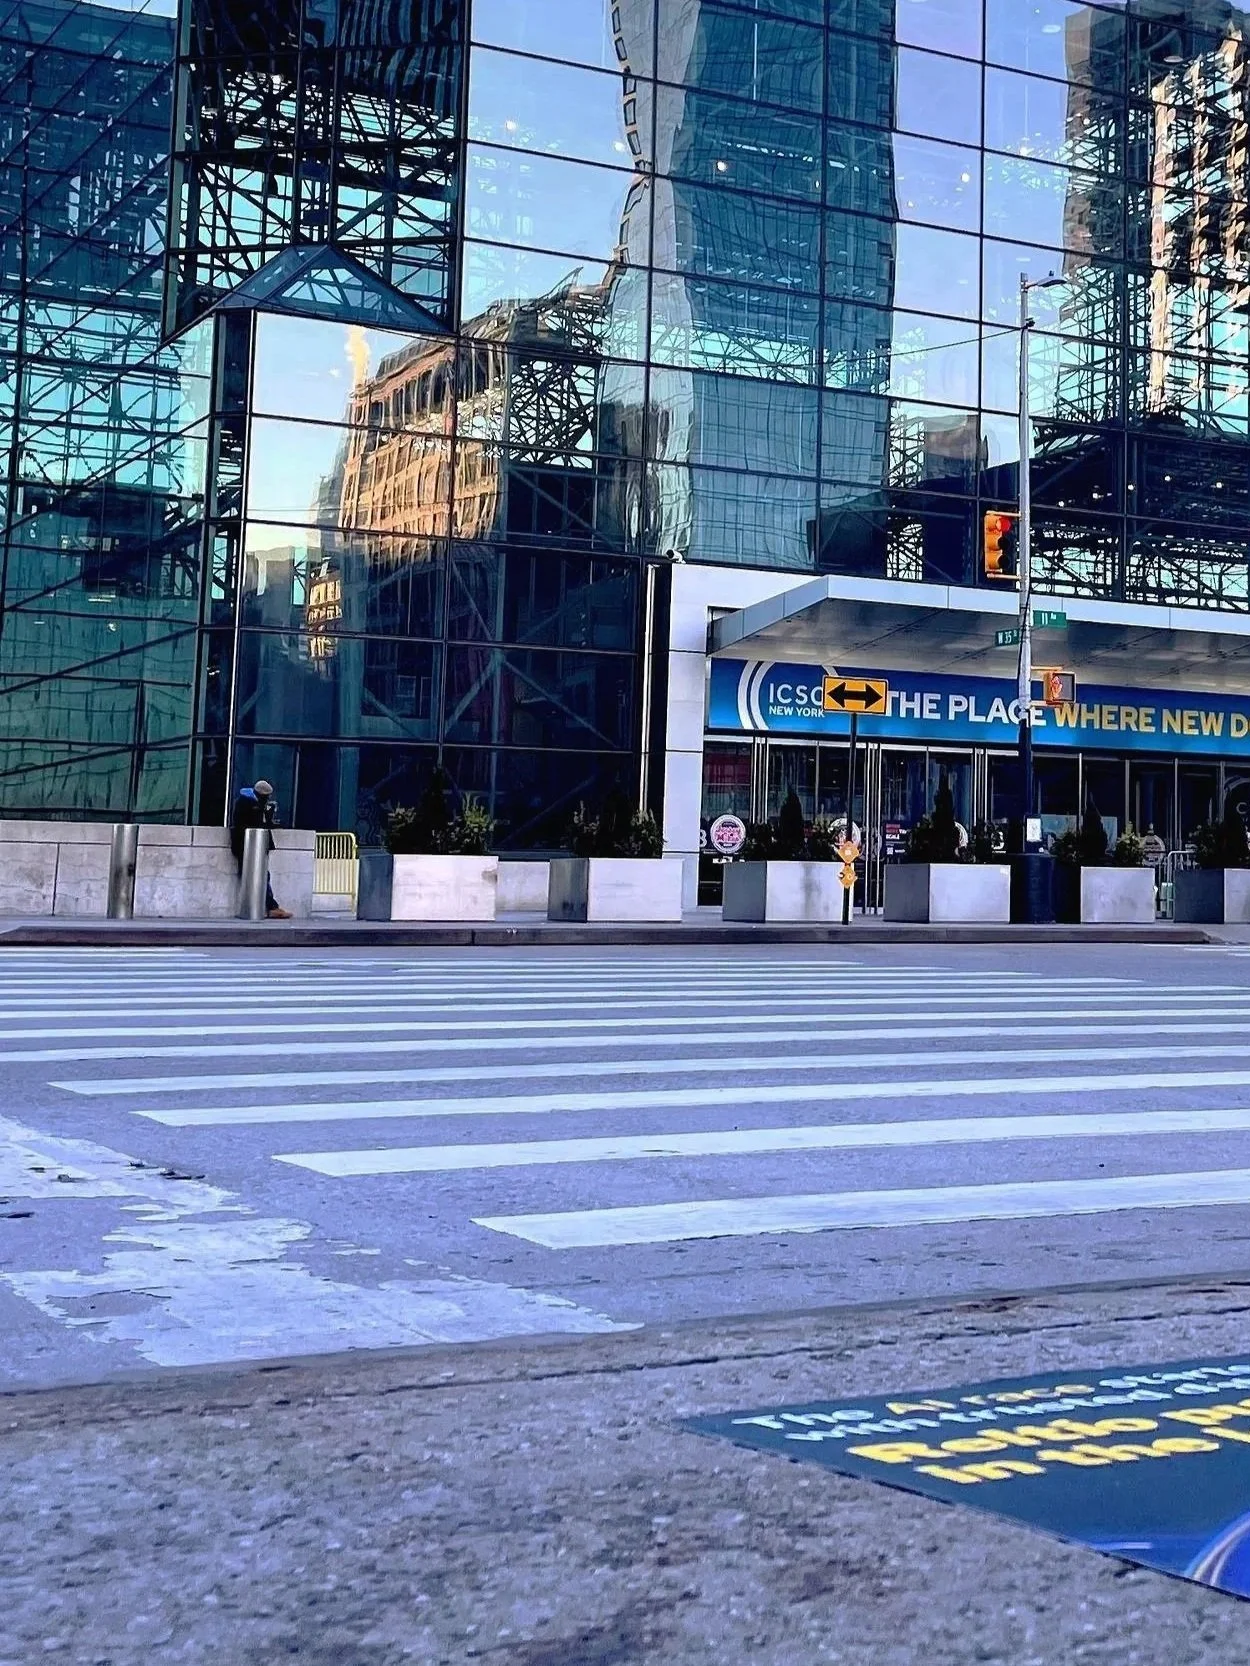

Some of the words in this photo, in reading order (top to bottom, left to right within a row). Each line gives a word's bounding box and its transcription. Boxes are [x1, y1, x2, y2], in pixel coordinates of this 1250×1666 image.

[998, 632, 1003, 644] W
[1004, 630, 1012, 644] 35
[1042, 612, 1048, 625] 11
[768, 705, 793, 716] NEW
[795, 707, 825, 718] YORK
[769, 683, 823, 705] ICSC
[885, 691, 941, 719] THE
[948, 694, 1047, 726] PLACE
[1054, 702, 1156, 733] WHERE
[1162, 709, 1225, 737] NEW
[731, 1409, 874, 1429] The
[886, 1398, 957, 1414] AI
[960, 1384, 1095, 1405] race
[785, 1418, 940, 1441] with
[938, 1388, 1174, 1423] trusted
[846, 1416, 1159, 1464] Reltio
[913, 1460, 1047, 1484] in
[1036, 1436, 1220, 1466] the
